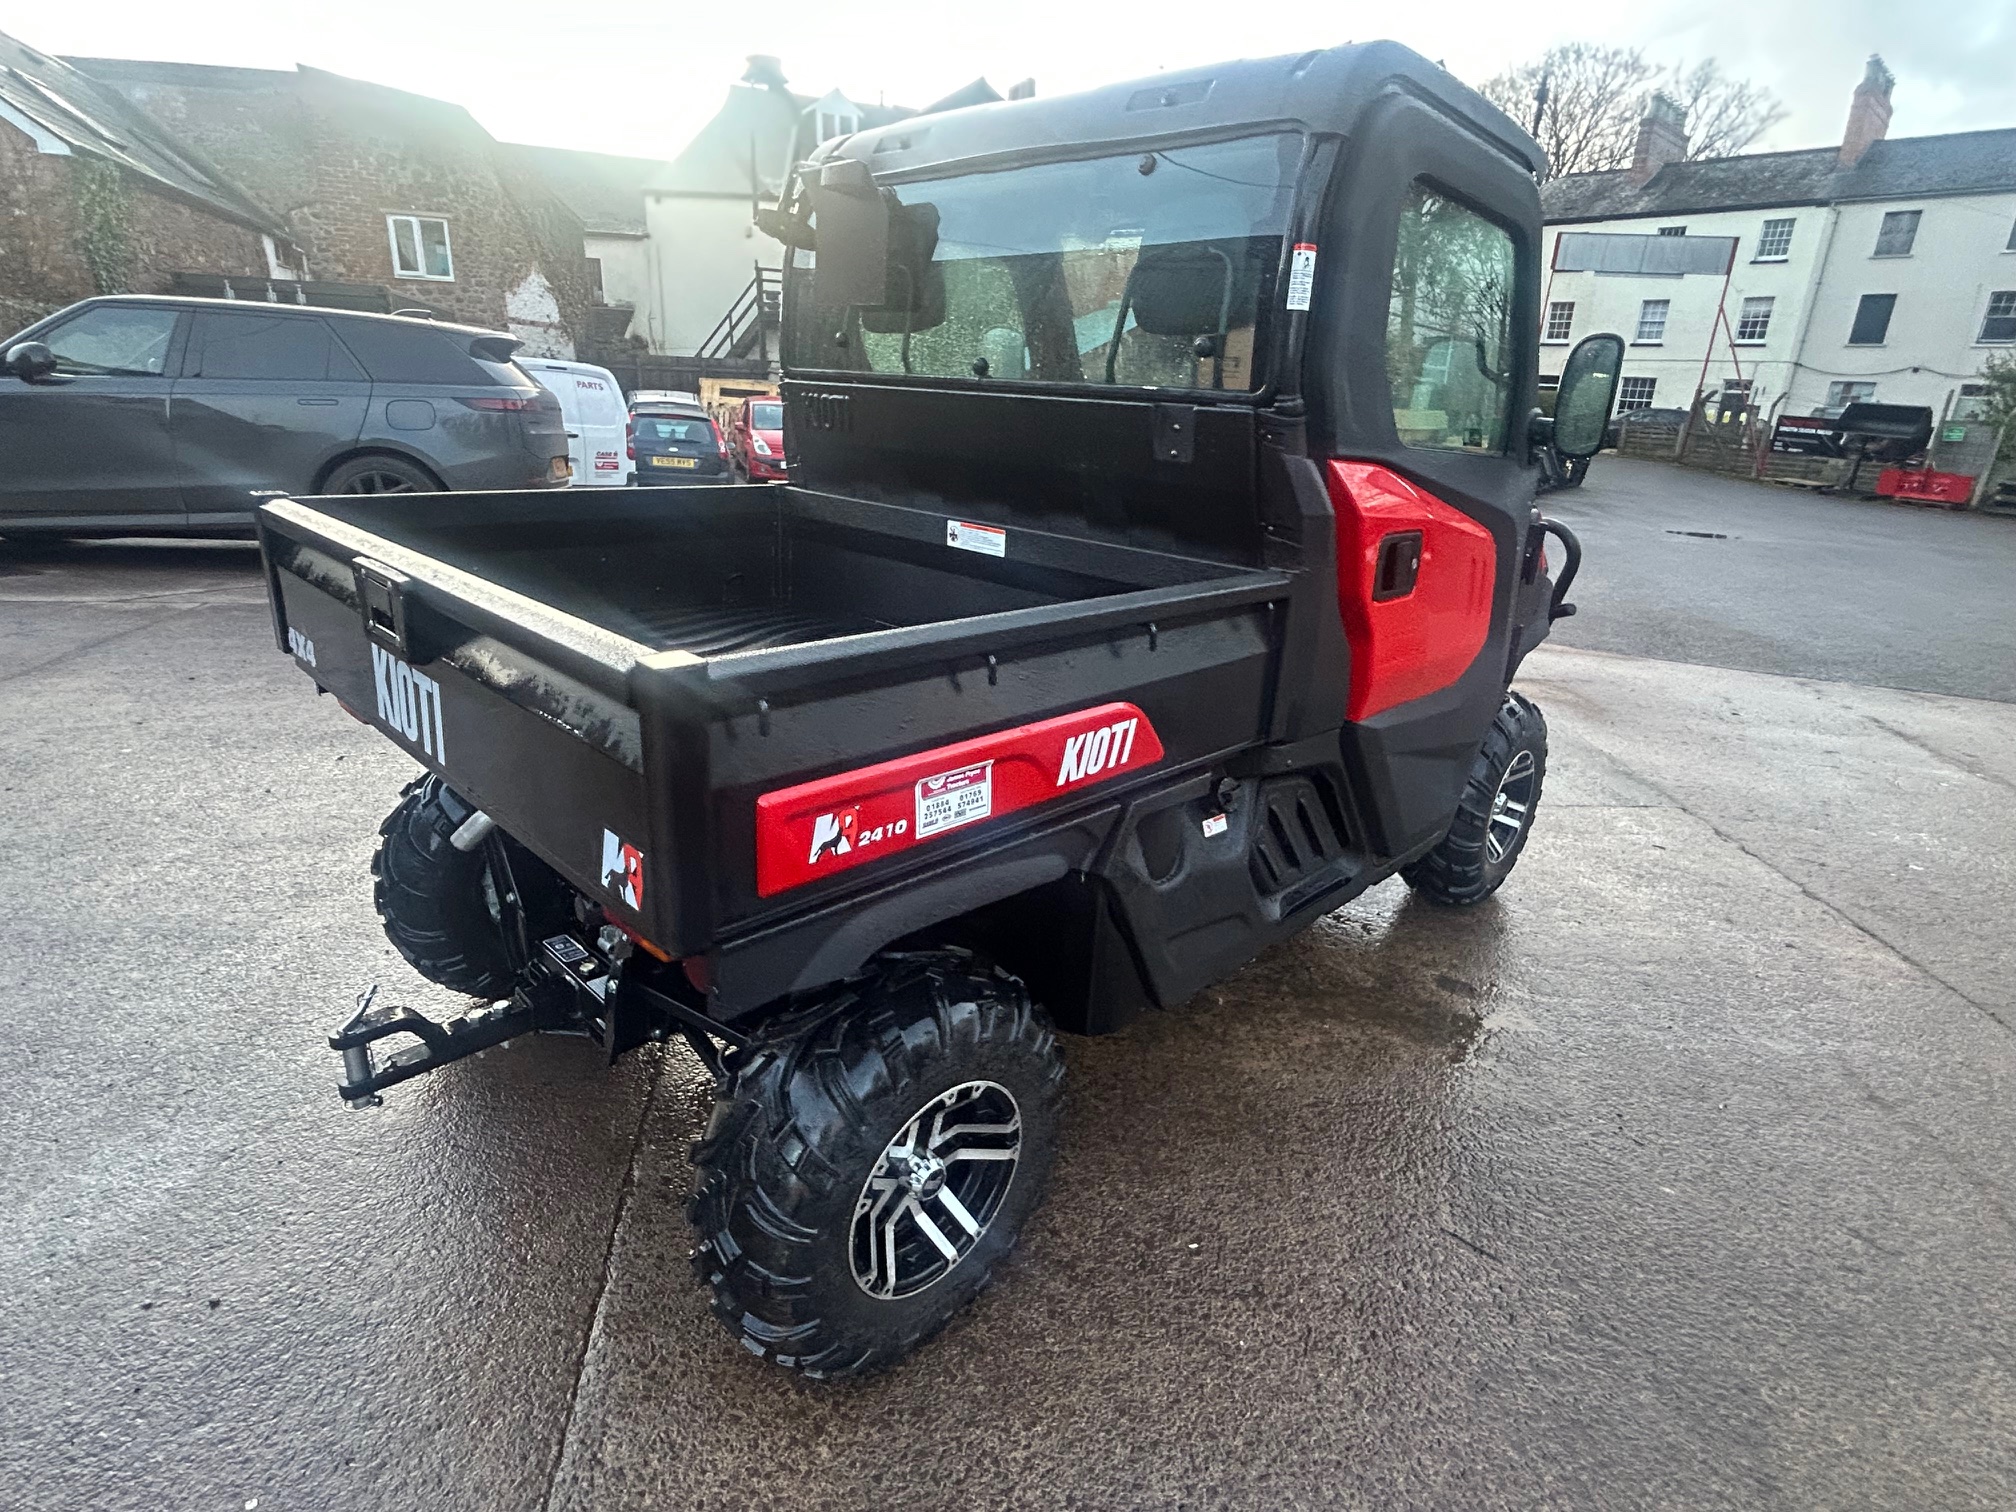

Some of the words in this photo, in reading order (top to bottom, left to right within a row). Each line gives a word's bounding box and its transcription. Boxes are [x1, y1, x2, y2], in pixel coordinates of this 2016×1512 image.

[576, 380, 604, 391] PARTS
[371, 641, 447, 766] KIOTI
[1056, 717, 1139, 787] KIOTI
[857, 818, 908, 848] 2410
